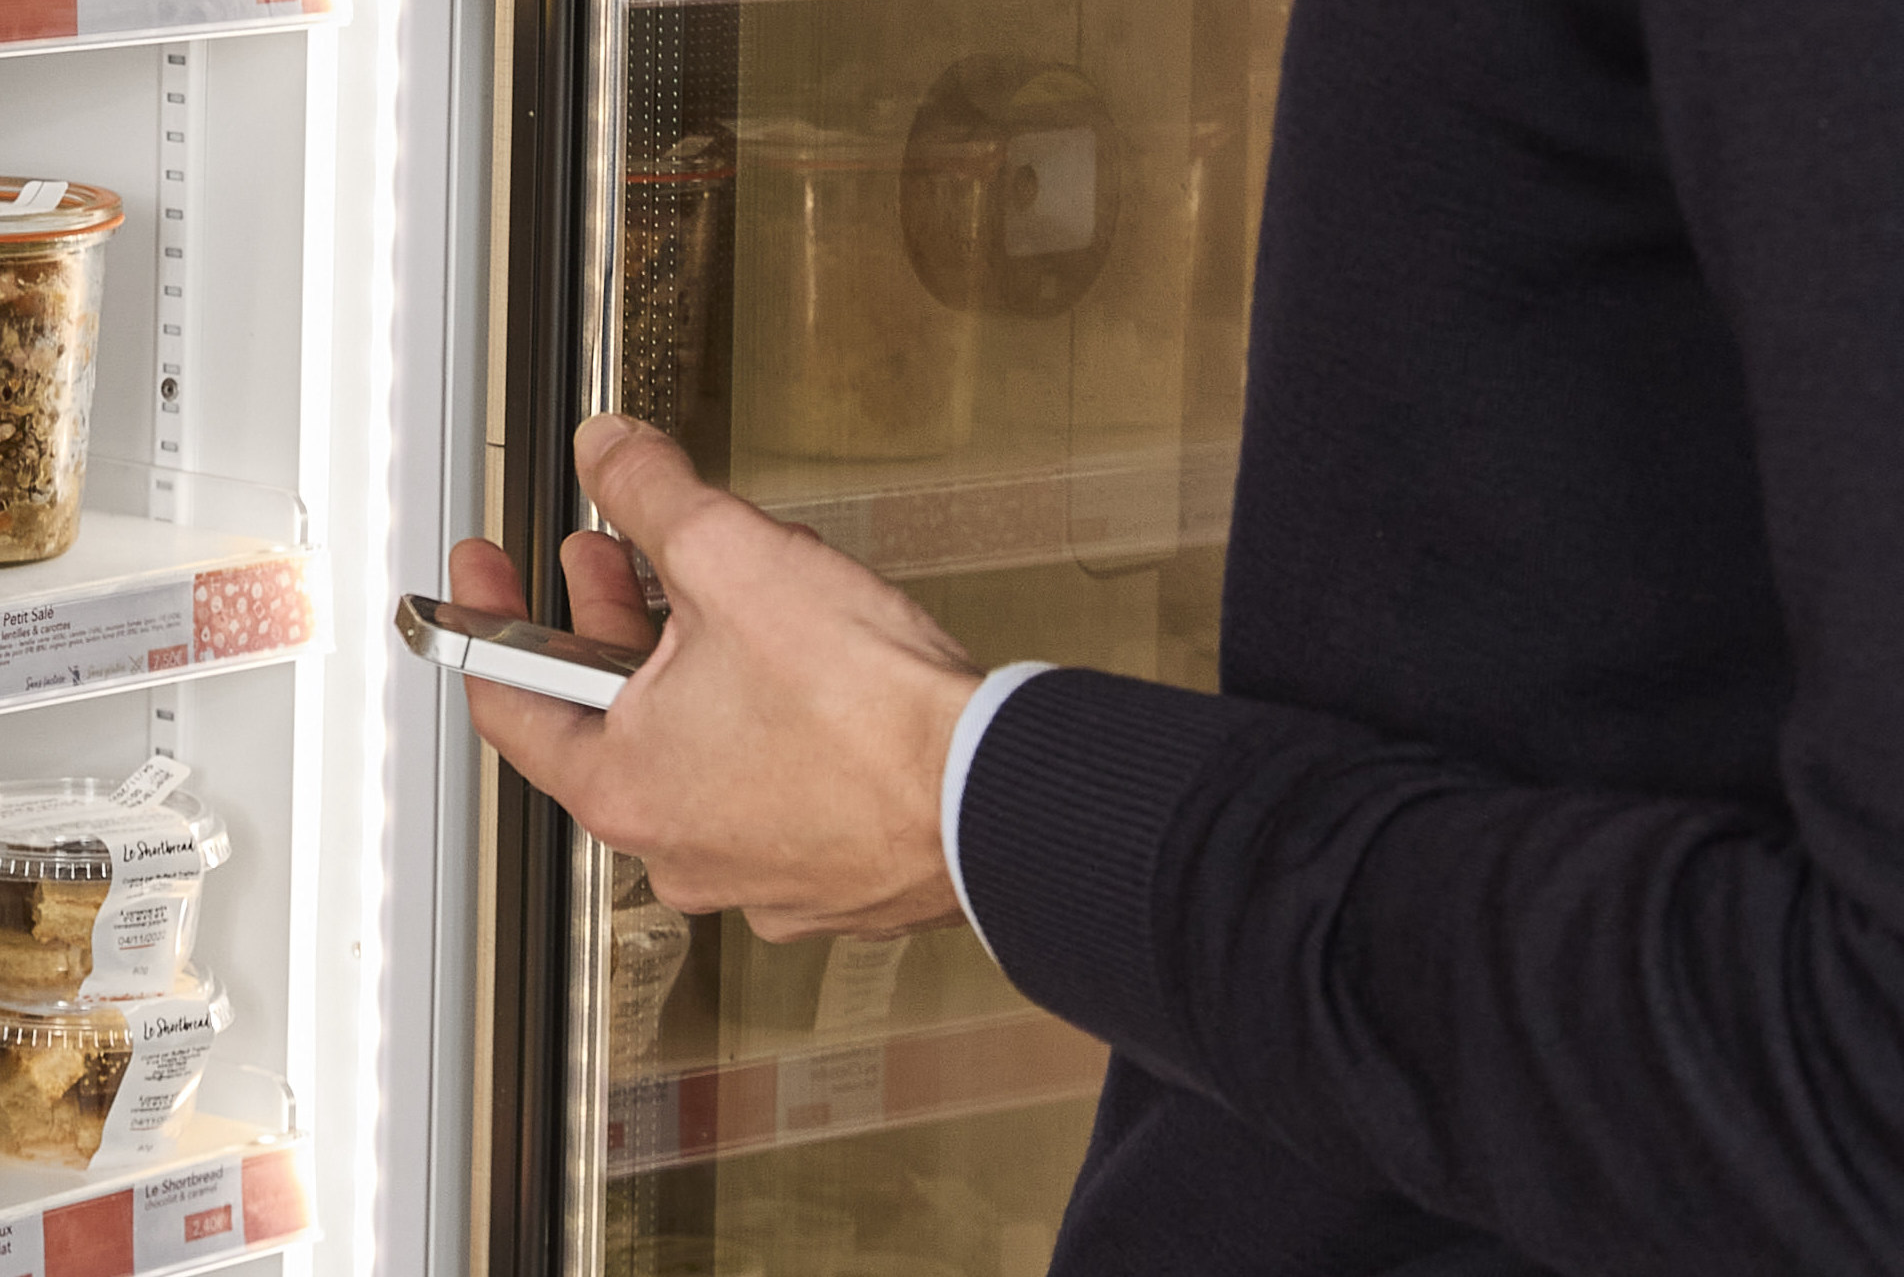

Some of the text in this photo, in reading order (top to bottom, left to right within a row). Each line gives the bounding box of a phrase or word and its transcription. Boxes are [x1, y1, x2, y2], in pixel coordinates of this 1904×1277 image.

[3, 612, 28, 626] Petit
[32, 607, 54, 621] Salé
[1, 626, 30, 640] lentilles
[41, 621, 71, 634] carottes
[124, 838, 194, 862] Le Shortbread
[144, 1014, 212, 1041] Le Shortbread
[145, 1164, 224, 1198] Le Shortbread
